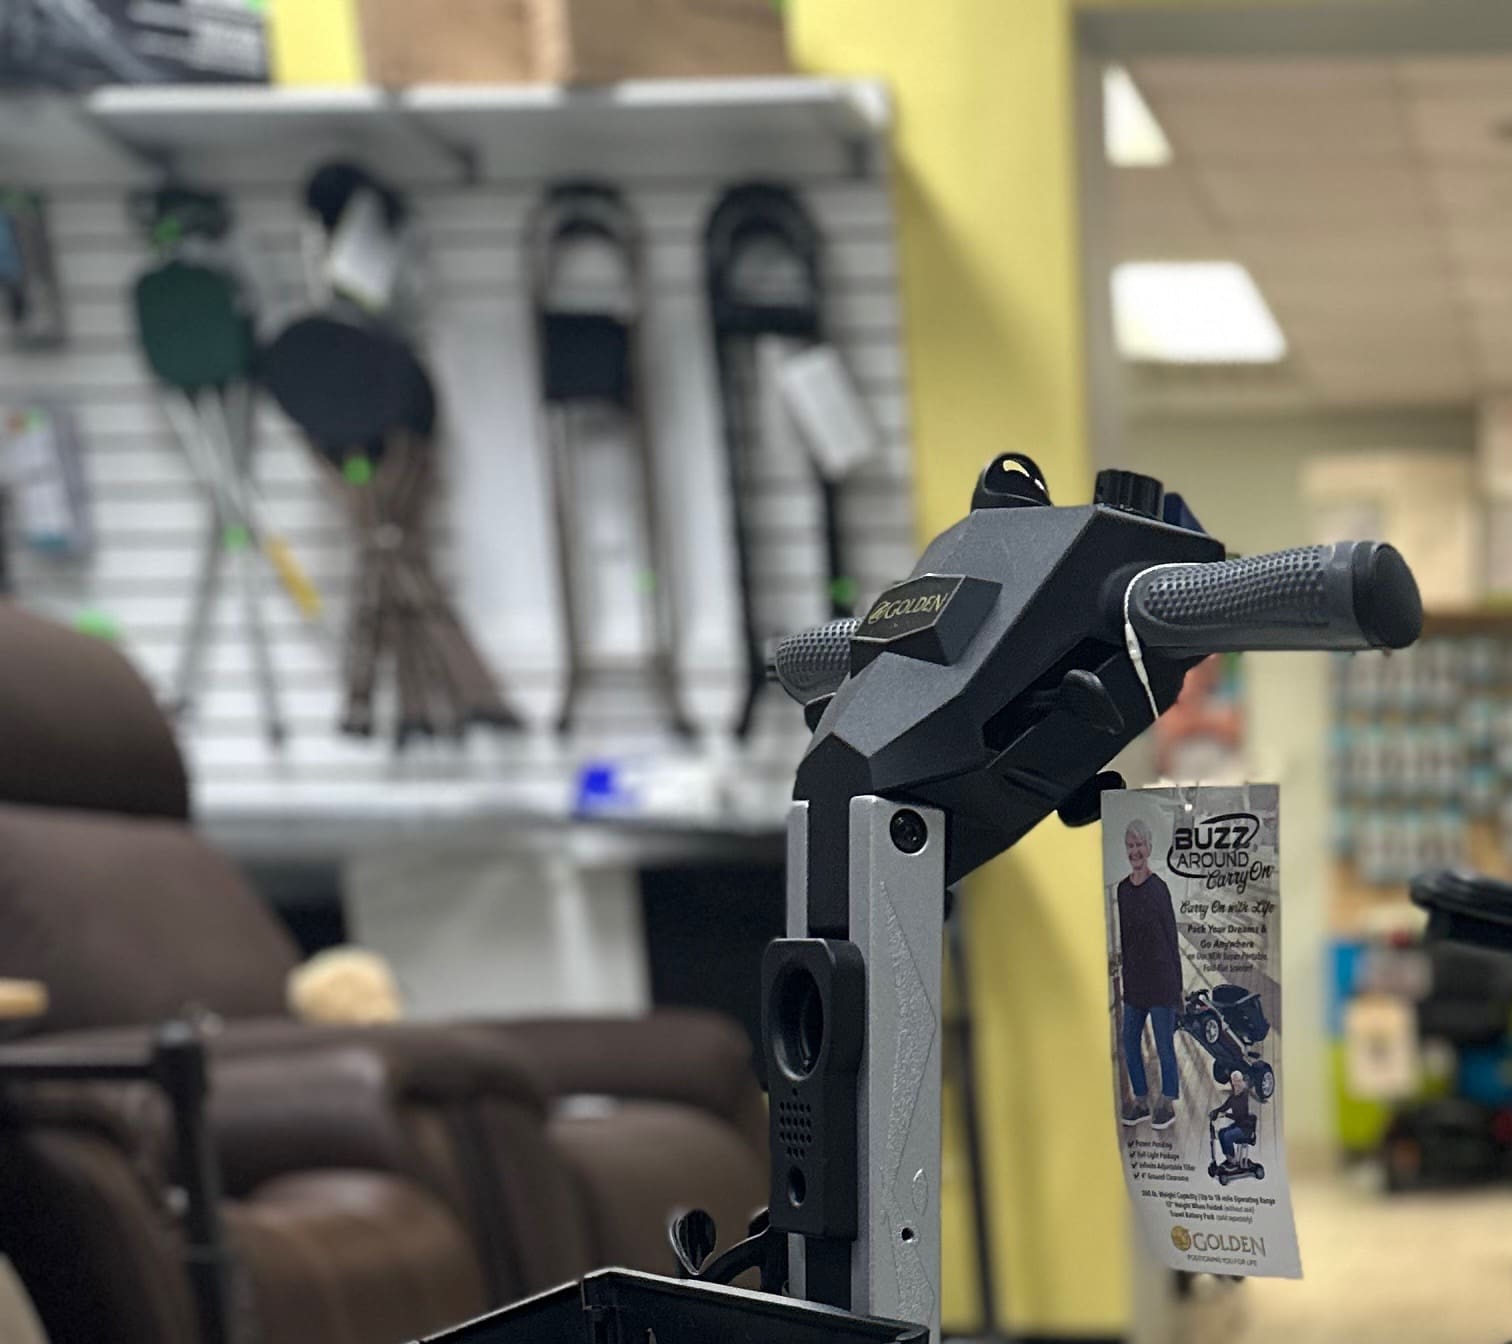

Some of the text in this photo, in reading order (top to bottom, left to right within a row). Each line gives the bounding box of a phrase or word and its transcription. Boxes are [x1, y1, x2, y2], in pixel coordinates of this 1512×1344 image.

[884, 593, 949, 619] GOLDEN
[1175, 826, 1251, 850] BUZZ
[1176, 851, 1249, 869] AROUND
[1180, 899, 1275, 920] Carry On with Life
[1187, 924, 1206, 934] Pack
[1208, 924, 1226, 934] Your
[1227, 925, 1259, 934] Dreams
[1200, 939, 1254, 950] Go Anywhere
[1176, 1192, 1197, 1201] Capacity
[1234, 1195, 1259, 1206] Operating
[1192, 1232, 1266, 1257] GOLDEN
